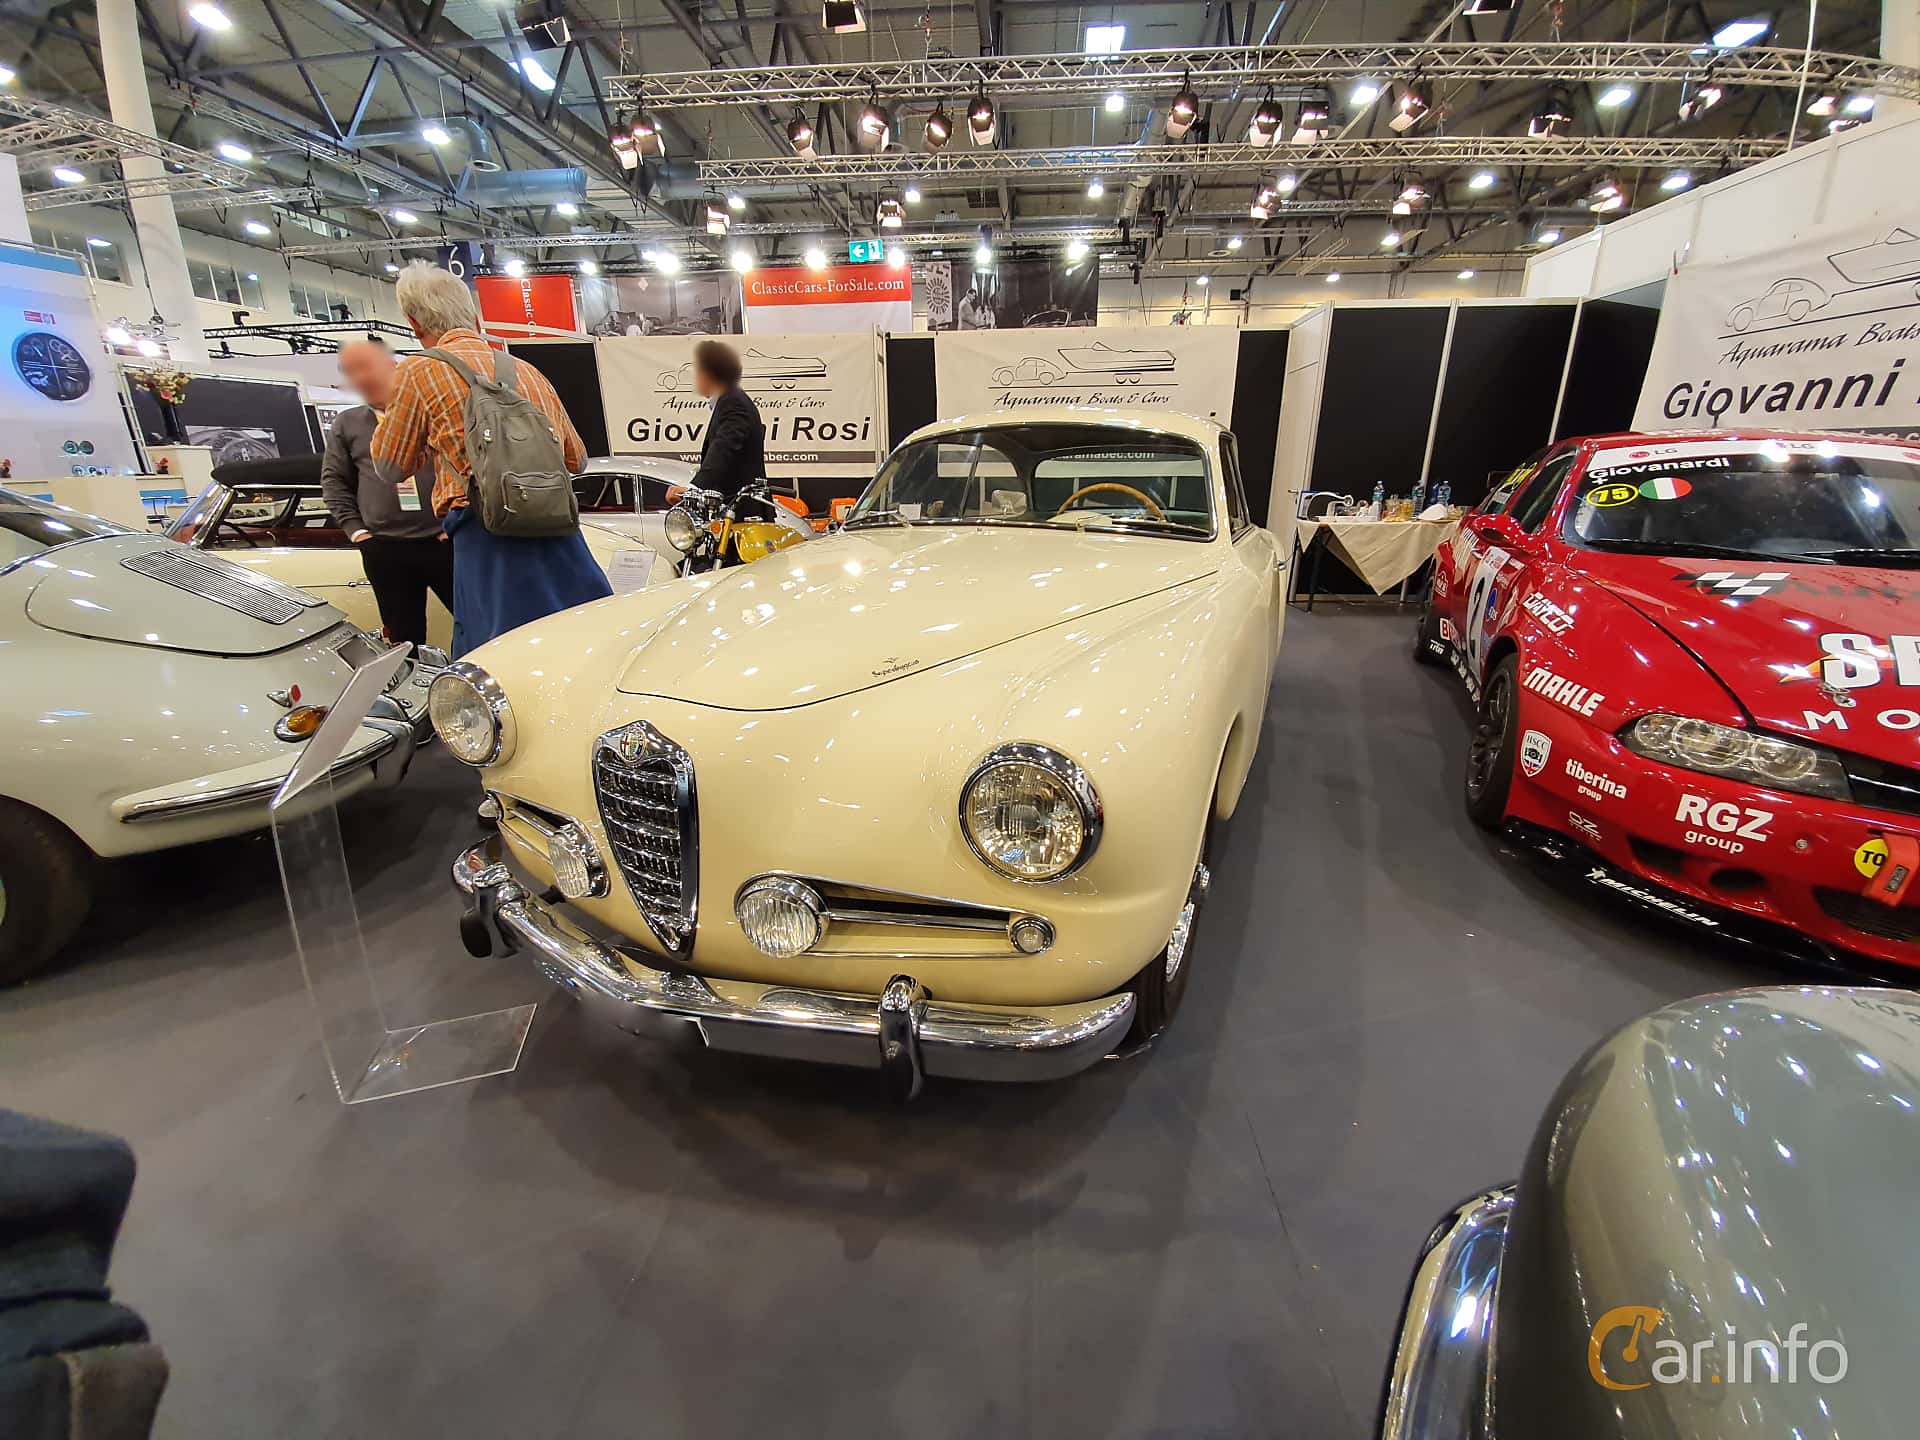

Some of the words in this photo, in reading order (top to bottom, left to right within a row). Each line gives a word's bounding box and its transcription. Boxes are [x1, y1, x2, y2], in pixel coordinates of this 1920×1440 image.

[448, 246, 465, 278] 6
[520, 278, 534, 318] Classic
[751, 277, 905, 295] ClassicCars-ForSale.com
[1718, 332, 1849, 369] Aquarama
[994, 391, 1082, 409] Aquarama
[1087, 391, 1123, 405] Boats
[1127, 392, 1140, 404] &
[1142, 391, 1169, 405] Cars
[1663, 358, 1907, 420] Giovanni
[662, 396, 710, 413] Aquar
[786, 397, 797, 409] &
[800, 396, 826, 409] Cars
[627, 417, 780, 442] Giovi
[791, 416, 872, 442] Rosi
[1588, 456, 1730, 480] Giovanardi
[1595, 487, 1630, 503] 75
[1523, 667, 1605, 717] MAHLE
[1526, 735, 1549, 750] HSCC
[1565, 758, 1627, 799] tiberina
[1577, 785, 1602, 801] group
[1675, 794, 1775, 842] RGZ
[1684, 829, 1745, 855] group
[1862, 850, 1887, 867] TO
[1599, 878, 1720, 927] MICHELIN
